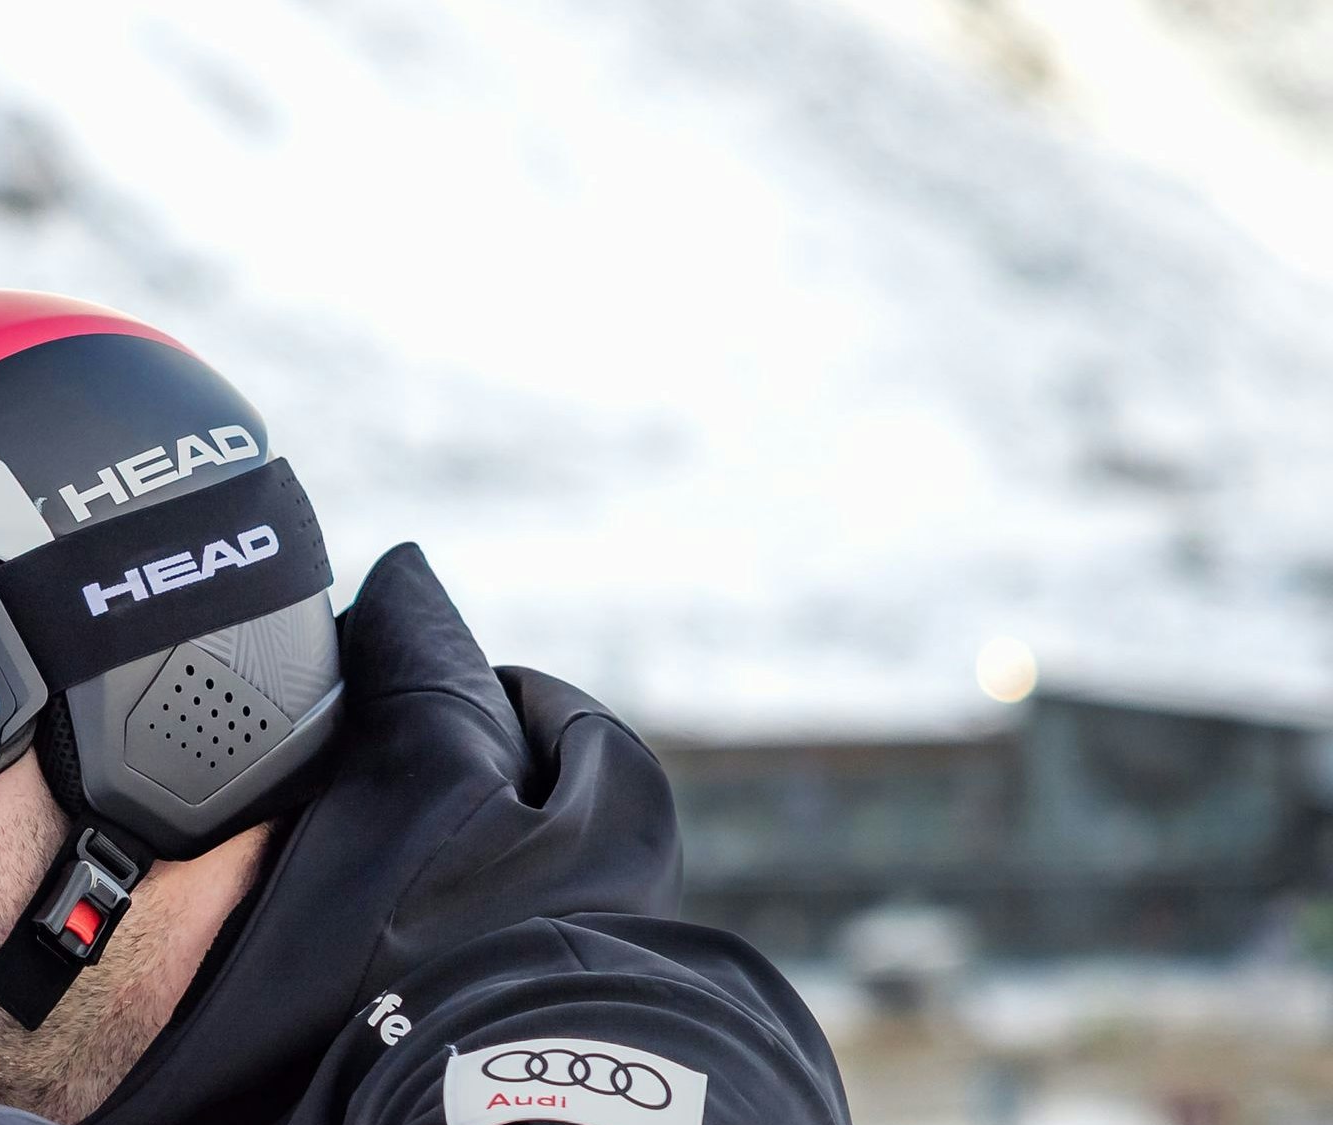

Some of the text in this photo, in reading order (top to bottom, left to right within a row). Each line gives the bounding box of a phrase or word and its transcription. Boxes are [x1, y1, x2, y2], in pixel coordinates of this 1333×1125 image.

[58, 425, 259, 523] HEAD
[82, 524, 280, 617] HEAD
[361, 991, 412, 1046] fe
[486, 1092, 567, 1110] Audi
